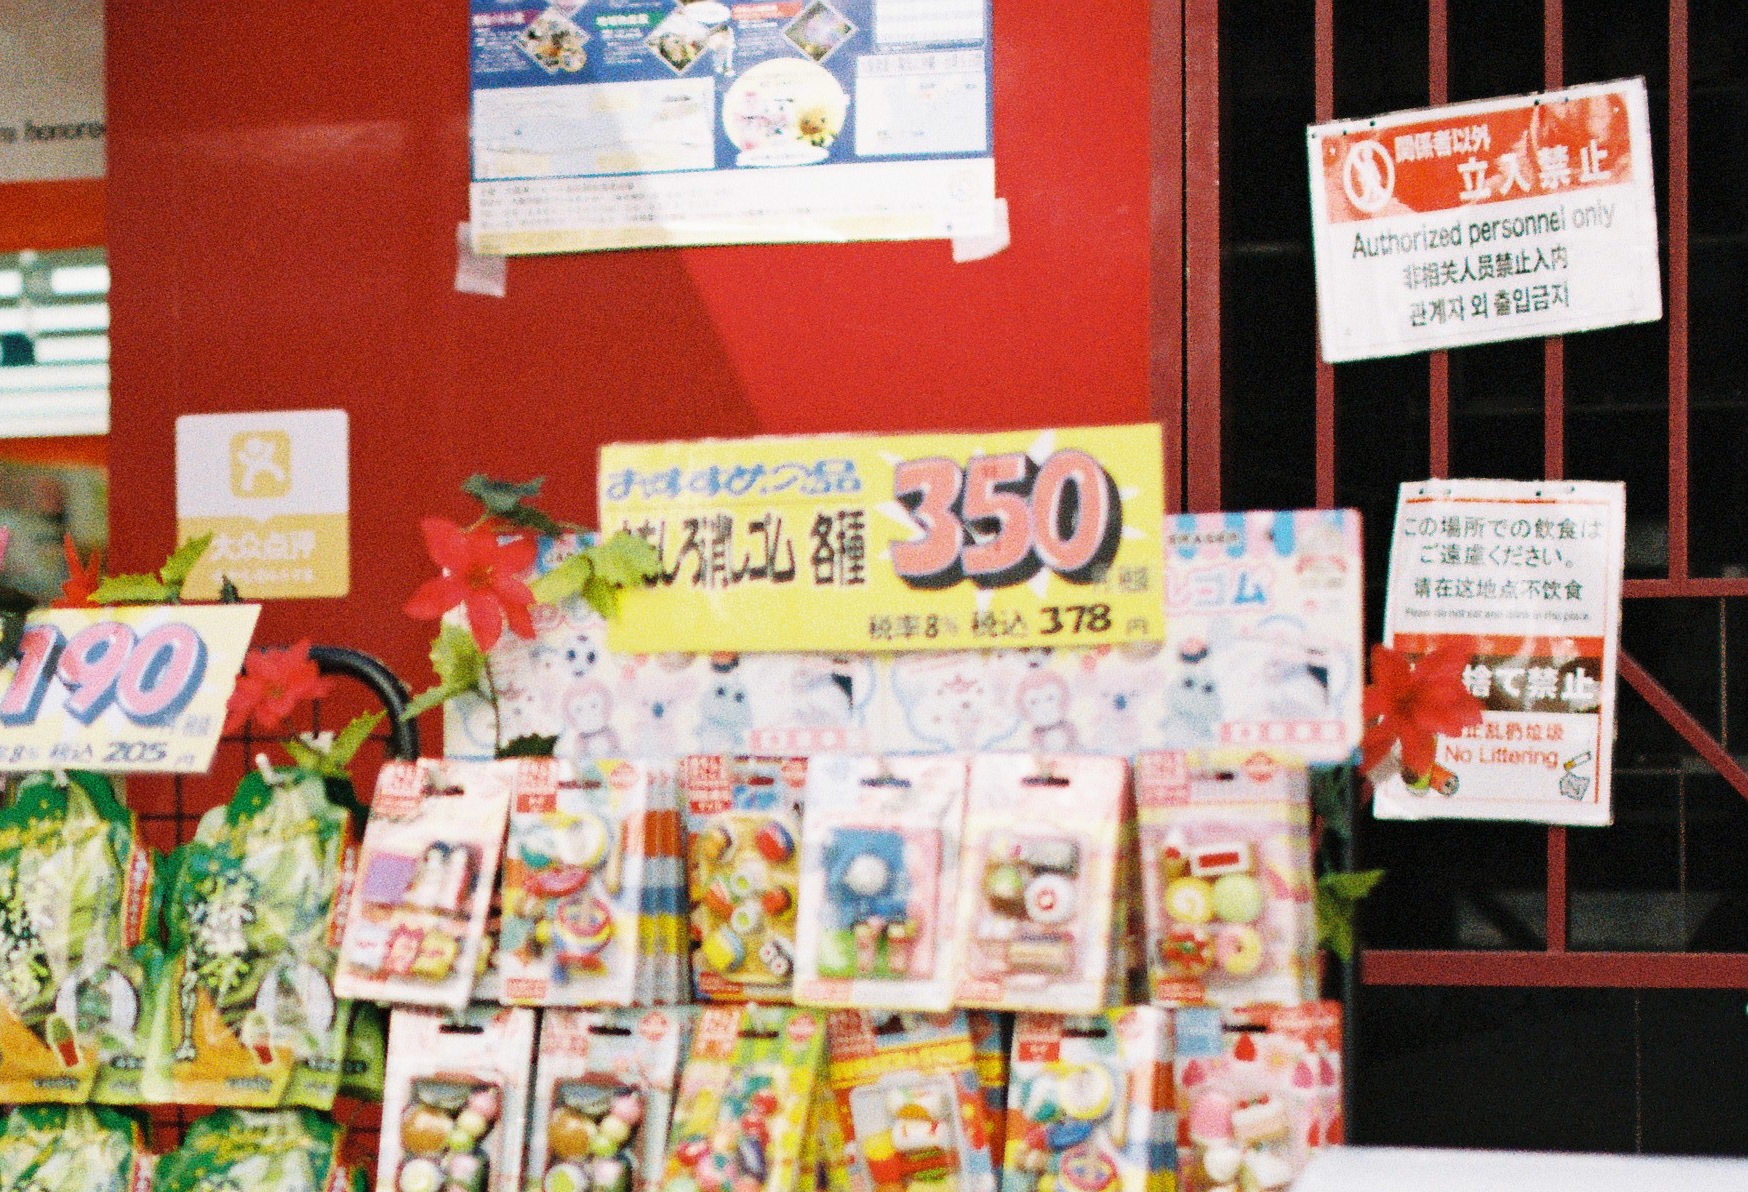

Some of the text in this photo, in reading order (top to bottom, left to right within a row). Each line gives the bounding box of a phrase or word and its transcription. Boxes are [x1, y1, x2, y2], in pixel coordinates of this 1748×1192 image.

[1457, 139, 1613, 201] 立入禁止
[1351, 198, 1616, 260] Authorized personnel only
[1471, 293, 1490, 320] 외
[1493, 282, 1571, 317] 출입금지
[888, 448, 1123, 591] 350
[1404, 516, 1605, 541] この場所での飲食は
[810, 510, 867, 588] 各種
[1420, 543, 1576, 568] ご遠慮ください。
[1039, 602, 1114, 636] 378
[102, 742, 167, 765] 205
[1445, 746, 1559, 769] No Littering
